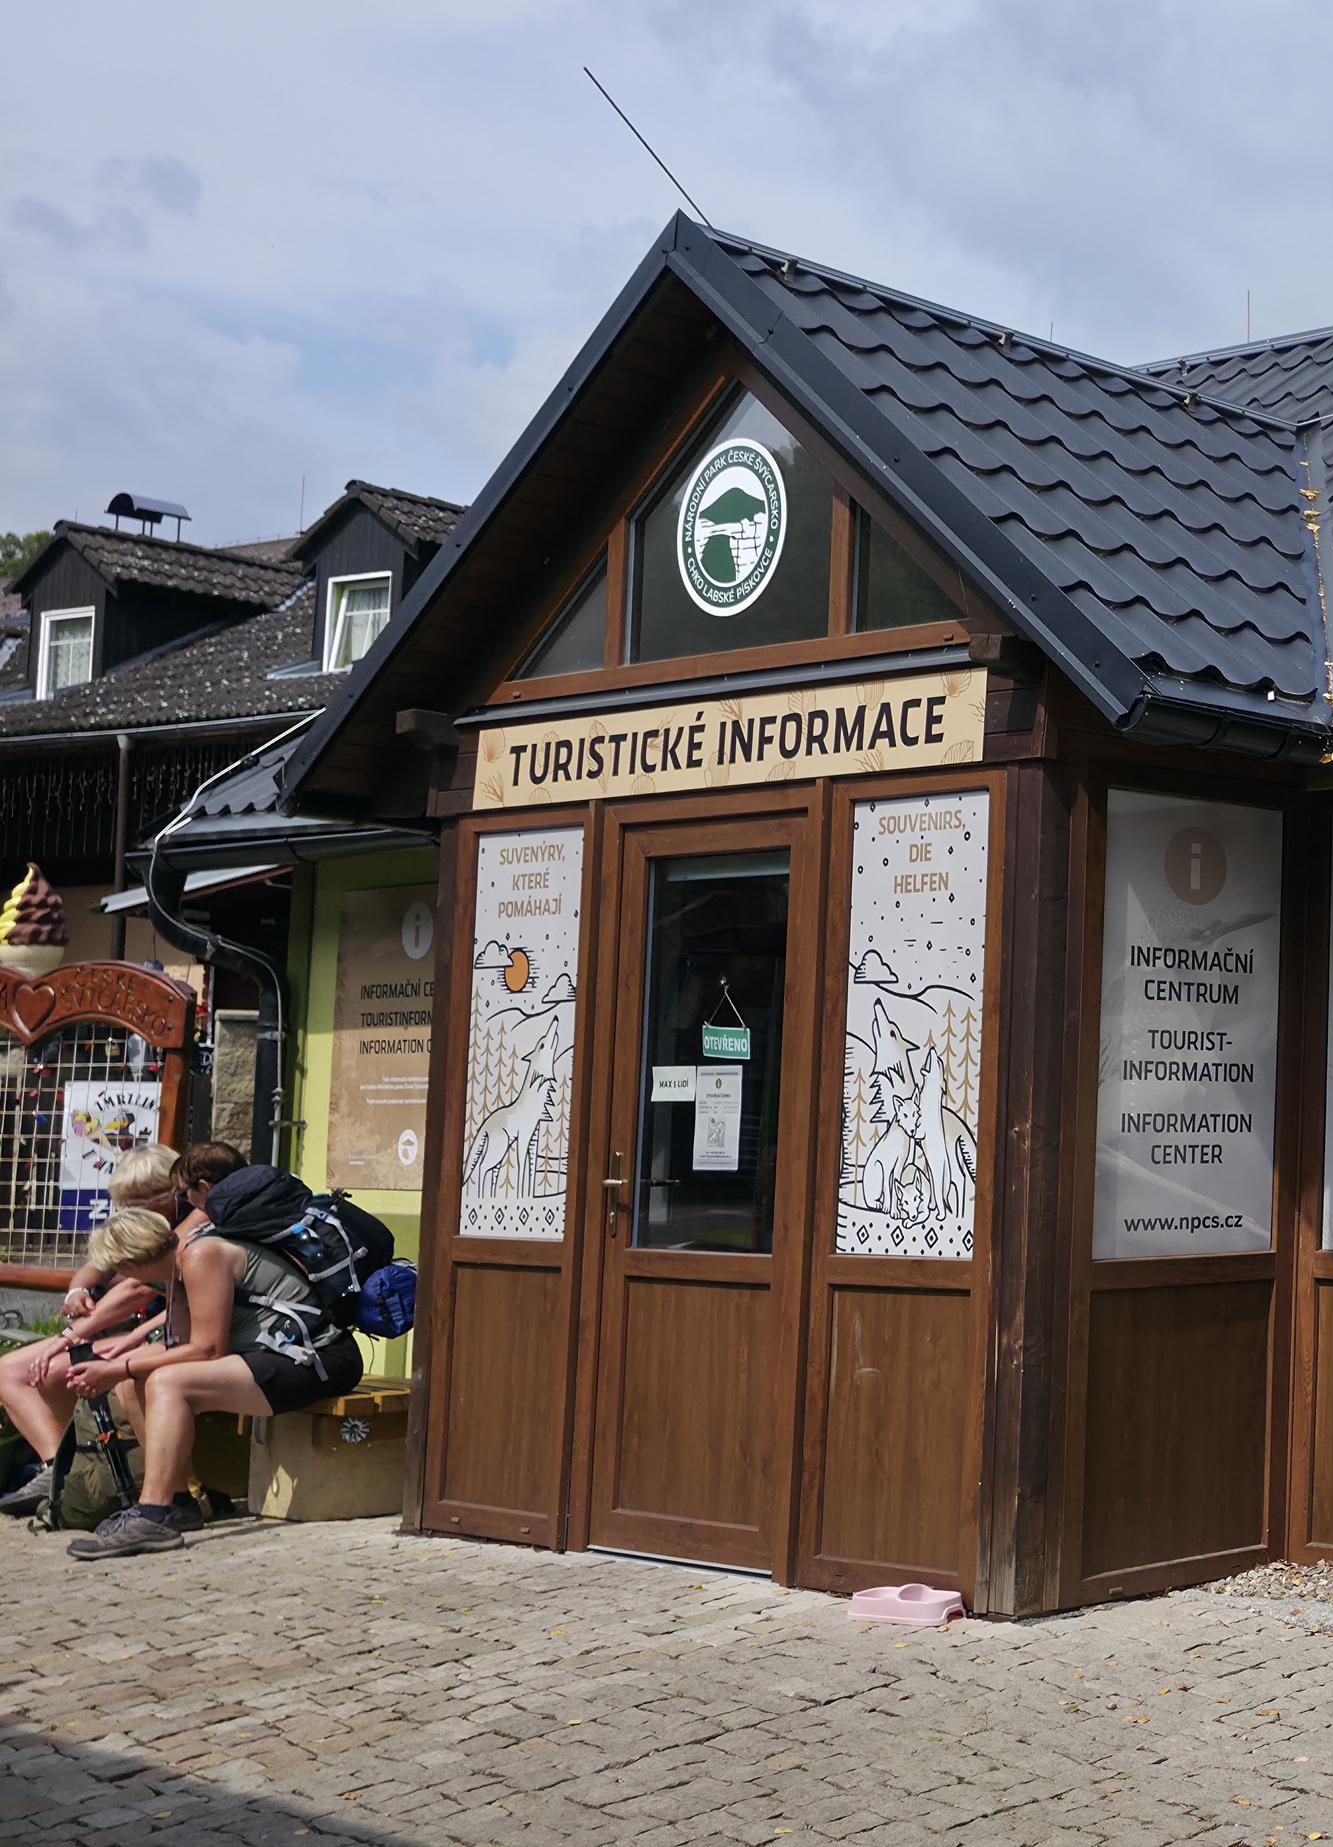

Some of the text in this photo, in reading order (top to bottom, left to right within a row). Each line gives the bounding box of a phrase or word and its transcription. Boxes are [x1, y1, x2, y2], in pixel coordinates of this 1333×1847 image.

[685, 449, 779, 541] NÁRODNÍ PARK ČESKÉ ŠVÝCARSKO
[686, 547, 773, 603] CHKO LABSKÉ PÍSKOVCE
[510, 696, 947, 788] TURISTICKÉ INFORMACE
[878, 809, 966, 836] SOUVENIRS,
[499, 840, 566, 867] SUVENÝRY,
[908, 840, 933, 865] DIE
[511, 867, 550, 893] KTERÉ
[893, 869, 950, 895] HELFEN
[497, 892, 563, 920] POMÁHAJÍ
[1130, 944, 1254, 975] INFORMAČNÍ
[360, 978, 421, 1000] INFORMAČNÍ
[1144, 979, 1239, 1006] CENTRUM
[359, 1039, 424, 1055] INFORMATION
[704, 1034, 748, 1052] OTEVŘENO
[1148, 1028, 1233, 1052] TOURIST-
[659, 1079, 672, 1088] MAX
[1122, 1059, 1254, 1083] INFORMATION
[1121, 1112, 1252, 1134] INFORMATION
[1150, 1143, 1223, 1165] CENTER
[1124, 1212, 1243, 1234] www.npcs.cz
